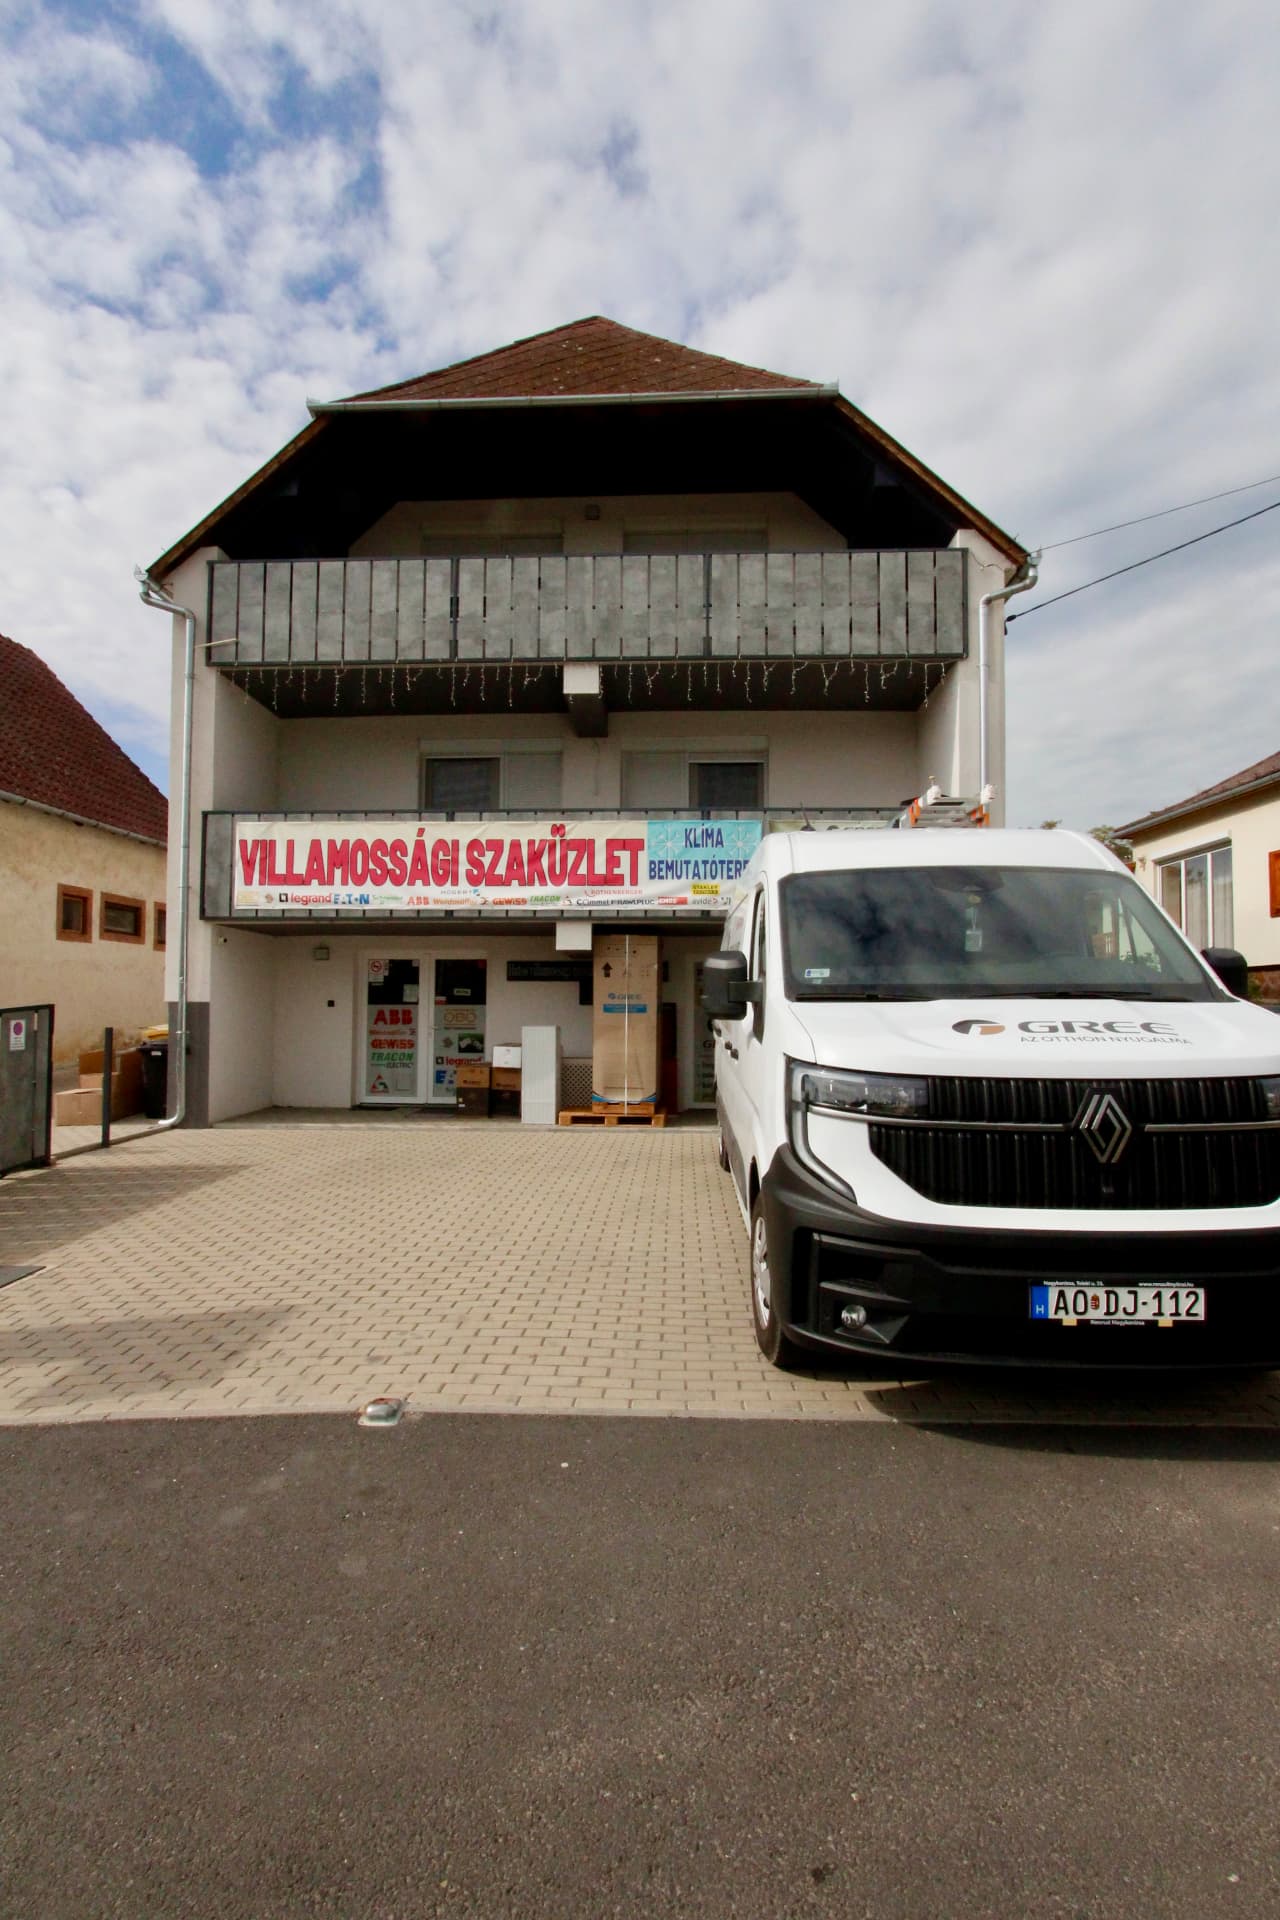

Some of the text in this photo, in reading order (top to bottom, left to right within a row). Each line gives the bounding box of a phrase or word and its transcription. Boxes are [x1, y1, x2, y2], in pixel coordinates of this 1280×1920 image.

[684, 823, 724, 849] KLÍMA
[239, 824, 645, 887] VILLAMOSSÁGI SZAKÜZLET
[290, 892, 332, 906] legrand
[407, 896, 430, 906] ABB
[373, 1009, 413, 1025] ABB
[1017, 1020, 1179, 1036] GREE
[371, 1052, 414, 1062] TRACON
[1035, 1304, 1044, 1315] H
[1054, 1289, 1200, 1318] AO DJ-112
